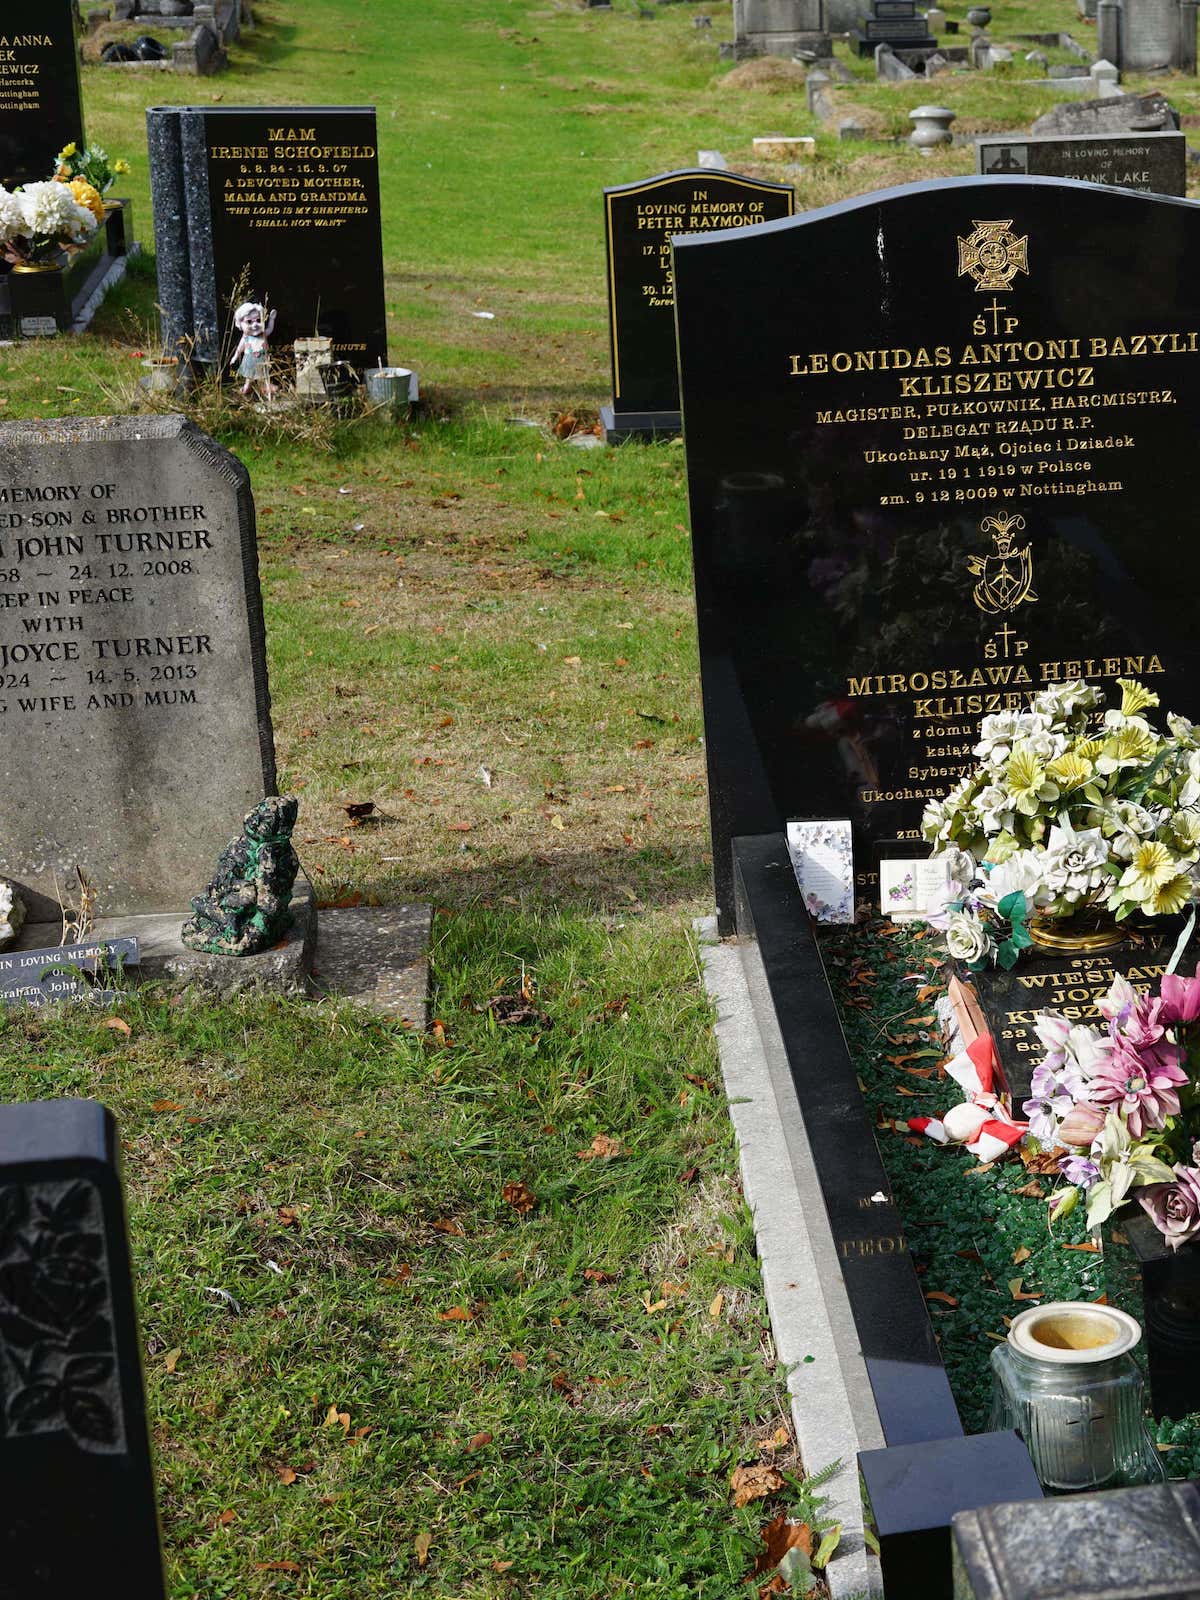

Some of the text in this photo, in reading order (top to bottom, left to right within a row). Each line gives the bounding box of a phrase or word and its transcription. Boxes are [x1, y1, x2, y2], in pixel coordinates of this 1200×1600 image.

[13, 34, 53, 47] ANNA
[0, 64, 40, 75] EWICZ
[267, 127, 316, 142] MAM
[211, 145, 376, 159] IRENE SCHOFIELD
[1062, 146, 1150, 159] IN LOVING MEMORY
[333, 164, 348, 173] 07
[1100, 161, 1112, 169] OF
[224, 177, 365, 189] A DEVOTED MOTHER,
[1114, 171, 1150, 183] LAKE
[224, 192, 367, 203] MAMA AND GRANDMA
[693, 190, 708, 201] IN
[253, 206, 281, 215] LORD
[283, 206, 293, 215] IS
[295, 206, 311, 215] MY
[313, 206, 369, 215] SHEPHERD
[637, 202, 765, 216] LOVING MEMORY OF
[249, 219, 254, 228] I
[255, 219, 289, 228] SHALL
[291, 219, 312, 227] NOT
[637, 213, 766, 230] PETER RAYMOND
[642, 245, 656, 256] 17.
[642, 285, 659, 296] 30.
[973, 313, 1019, 336] Ś P
[331, 343, 368, 351] INUTE
[788, 332, 1199, 376] LEONIDAS ANTONI BAZYLI
[899, 366, 1095, 398] KLISZEWICZ
[816, 390, 1177, 424] MAGISTER, PUŁKOWNIK, HARCMISTRZ,
[903, 416, 1095, 440] DELEGAT RZĄDU R.P.
[863, 434, 1136, 464] Ukochany Mąż, Ojciec i Dziadek
[910, 459, 1092, 482] ur. 19 1 1919 w Polsce
[91, 483, 117, 499] OF
[880, 480, 1124, 505] zm. 9 12 2009 w Nottingham
[32, 511, 73, 528] SON
[81, 509, 97, 525] &
[107, 504, 208, 524] BROTHER
[16, 529, 214, 563] JOHN TURNER
[69, 564, 98, 580] 24.
[109, 562, 134, 579] 12.
[143, 560, 193, 577] 2008
[38, 590, 60, 607] IN
[69, 587, 135, 605] PEACE
[23, 616, 84, 633] WITH
[0, 634, 214, 668] JOYCE TURNER
[984, 639, 1029, 659] Ś P
[87, 669, 113, 685] 14.
[124, 667, 140, 683] 5.
[151, 664, 198, 682] 2013
[847, 654, 1165, 697] MIROSŁAWA HELENA
[18, 695, 76, 713] WIFE
[87, 692, 134, 709] AND
[145, 688, 199, 706] MUM
[912, 729, 921, 739] z
[925, 724, 972, 738] domu
[862, 786, 945, 802] Ukochana
[20, 953, 61, 968] LOVING
[1071, 957, 1112, 970] syn
[48, 980, 78, 993] John
[1001, 1028, 1027, 1039] 23
